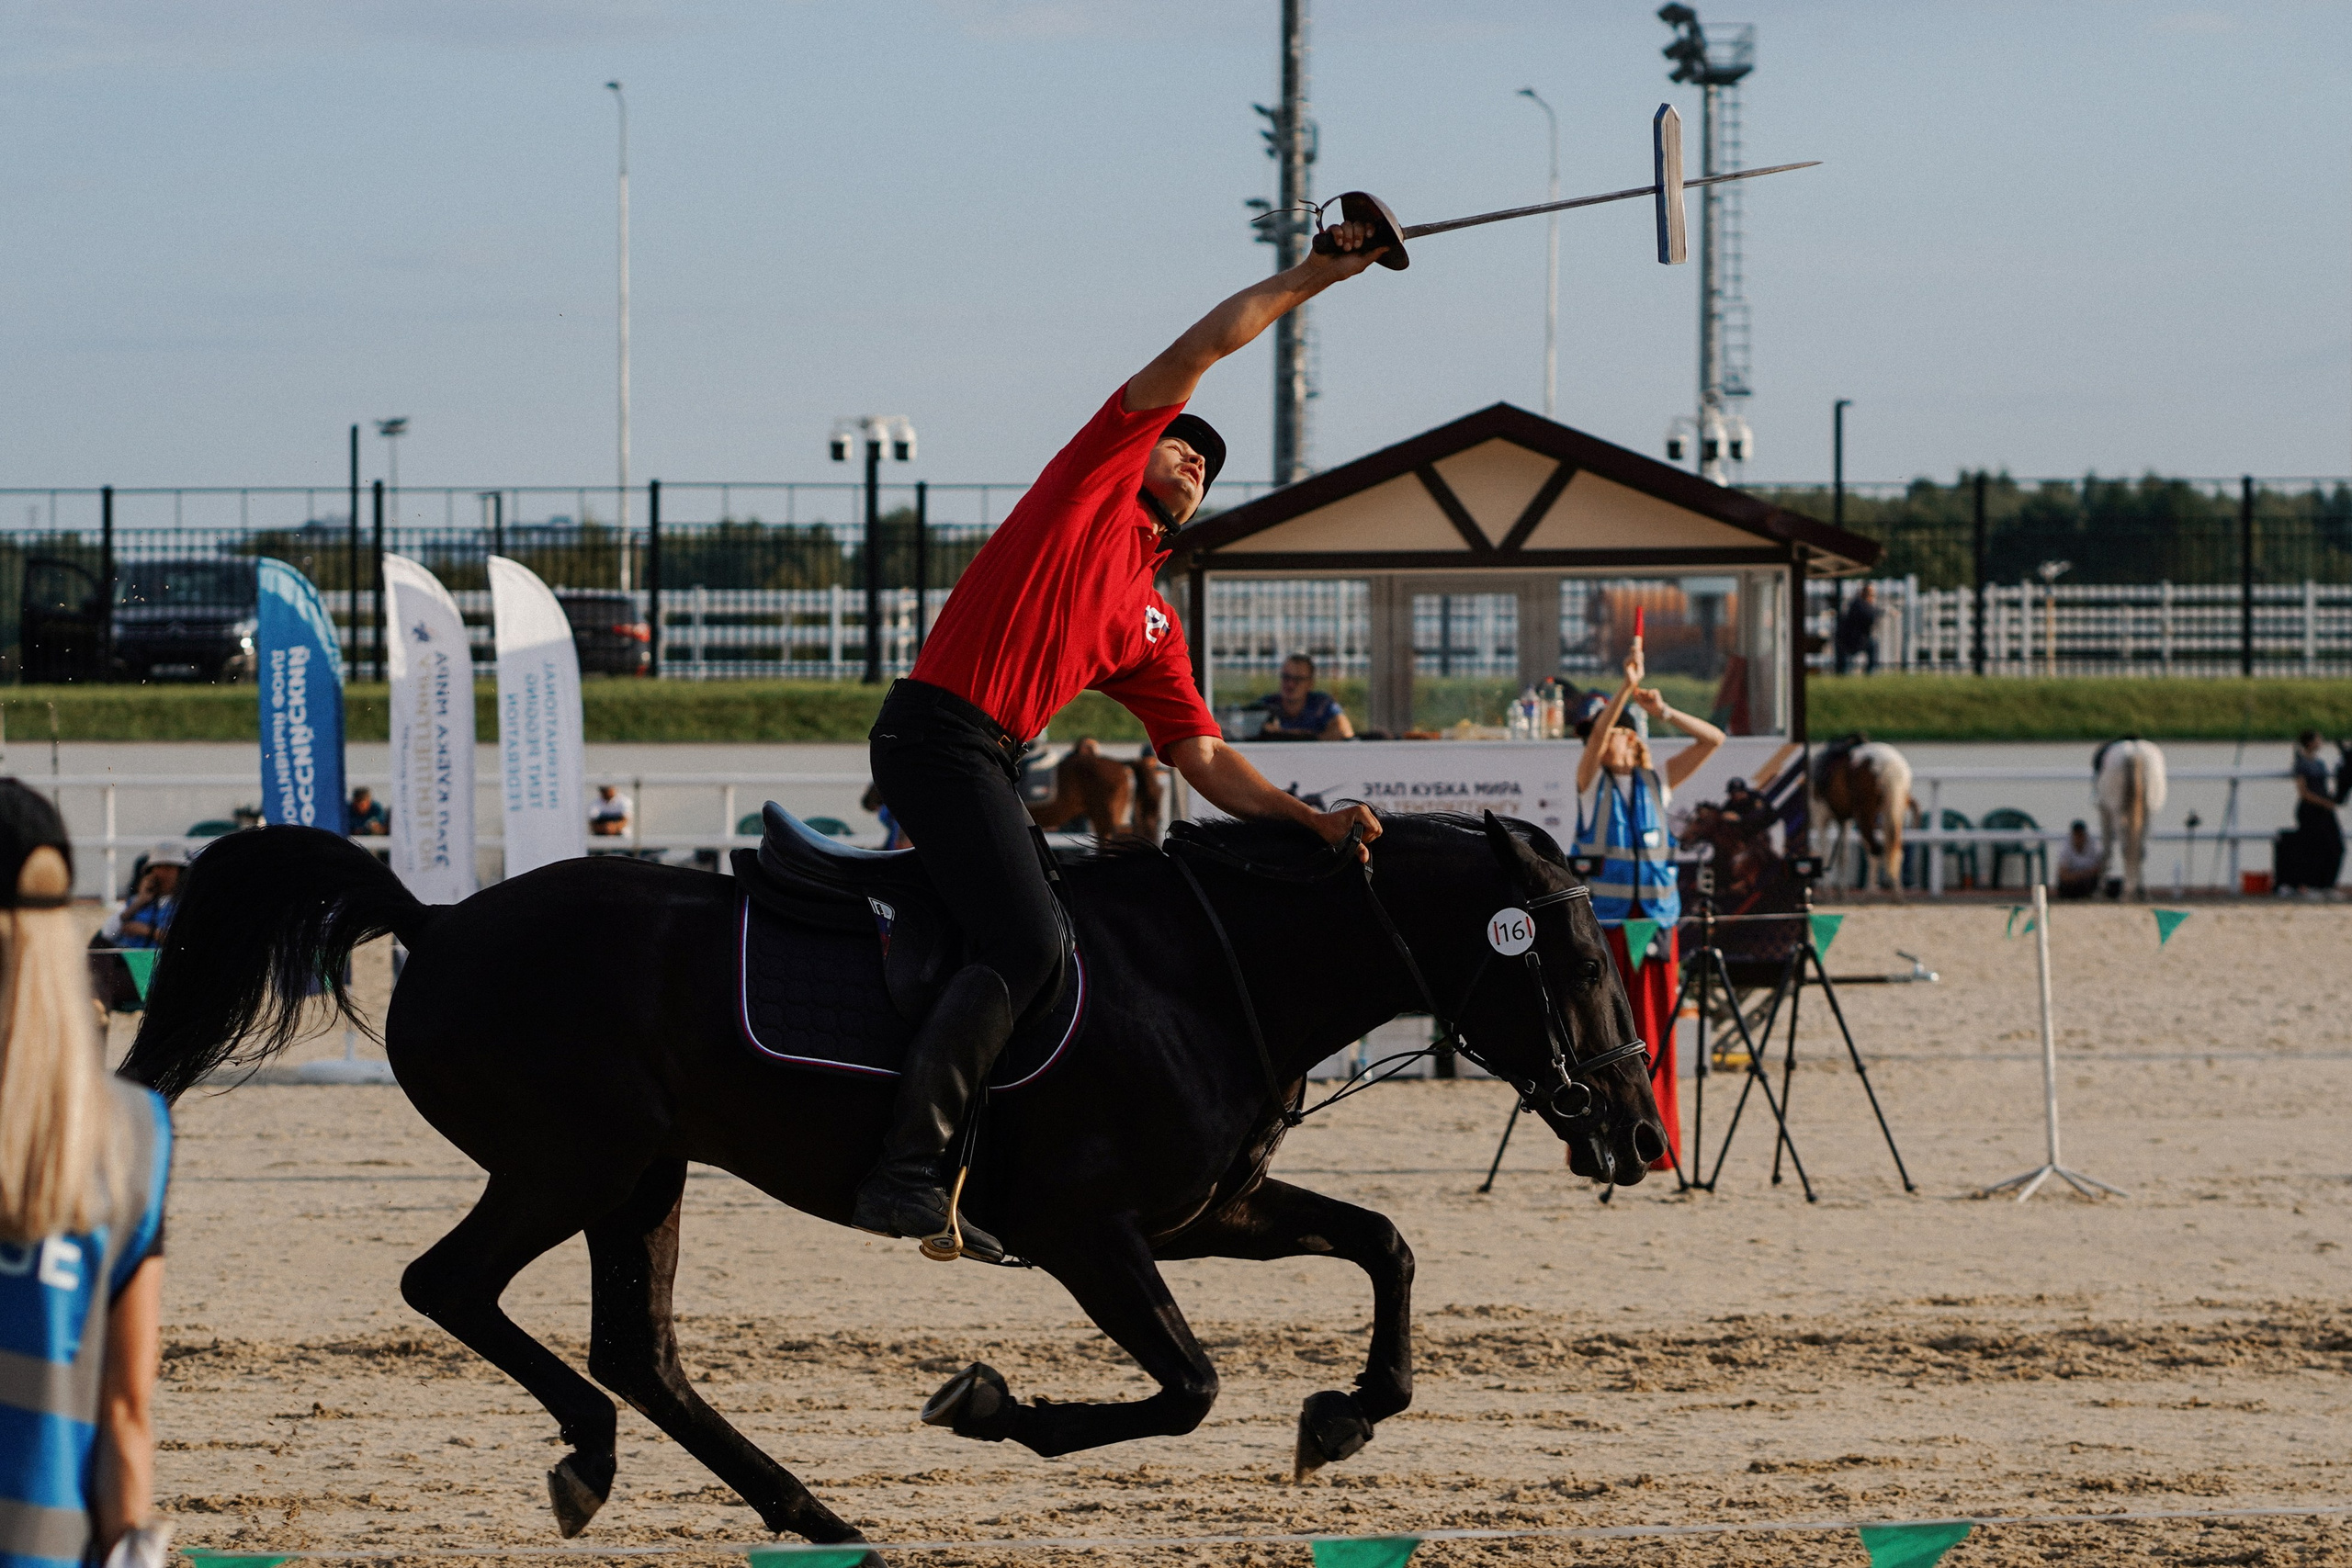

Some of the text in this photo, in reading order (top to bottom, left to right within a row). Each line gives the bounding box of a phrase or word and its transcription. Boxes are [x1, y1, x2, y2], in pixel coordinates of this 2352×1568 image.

[1363, 781, 1522, 797] ЭТАП КУБКА МИРА
[1499, 920, 1525, 942] 16
